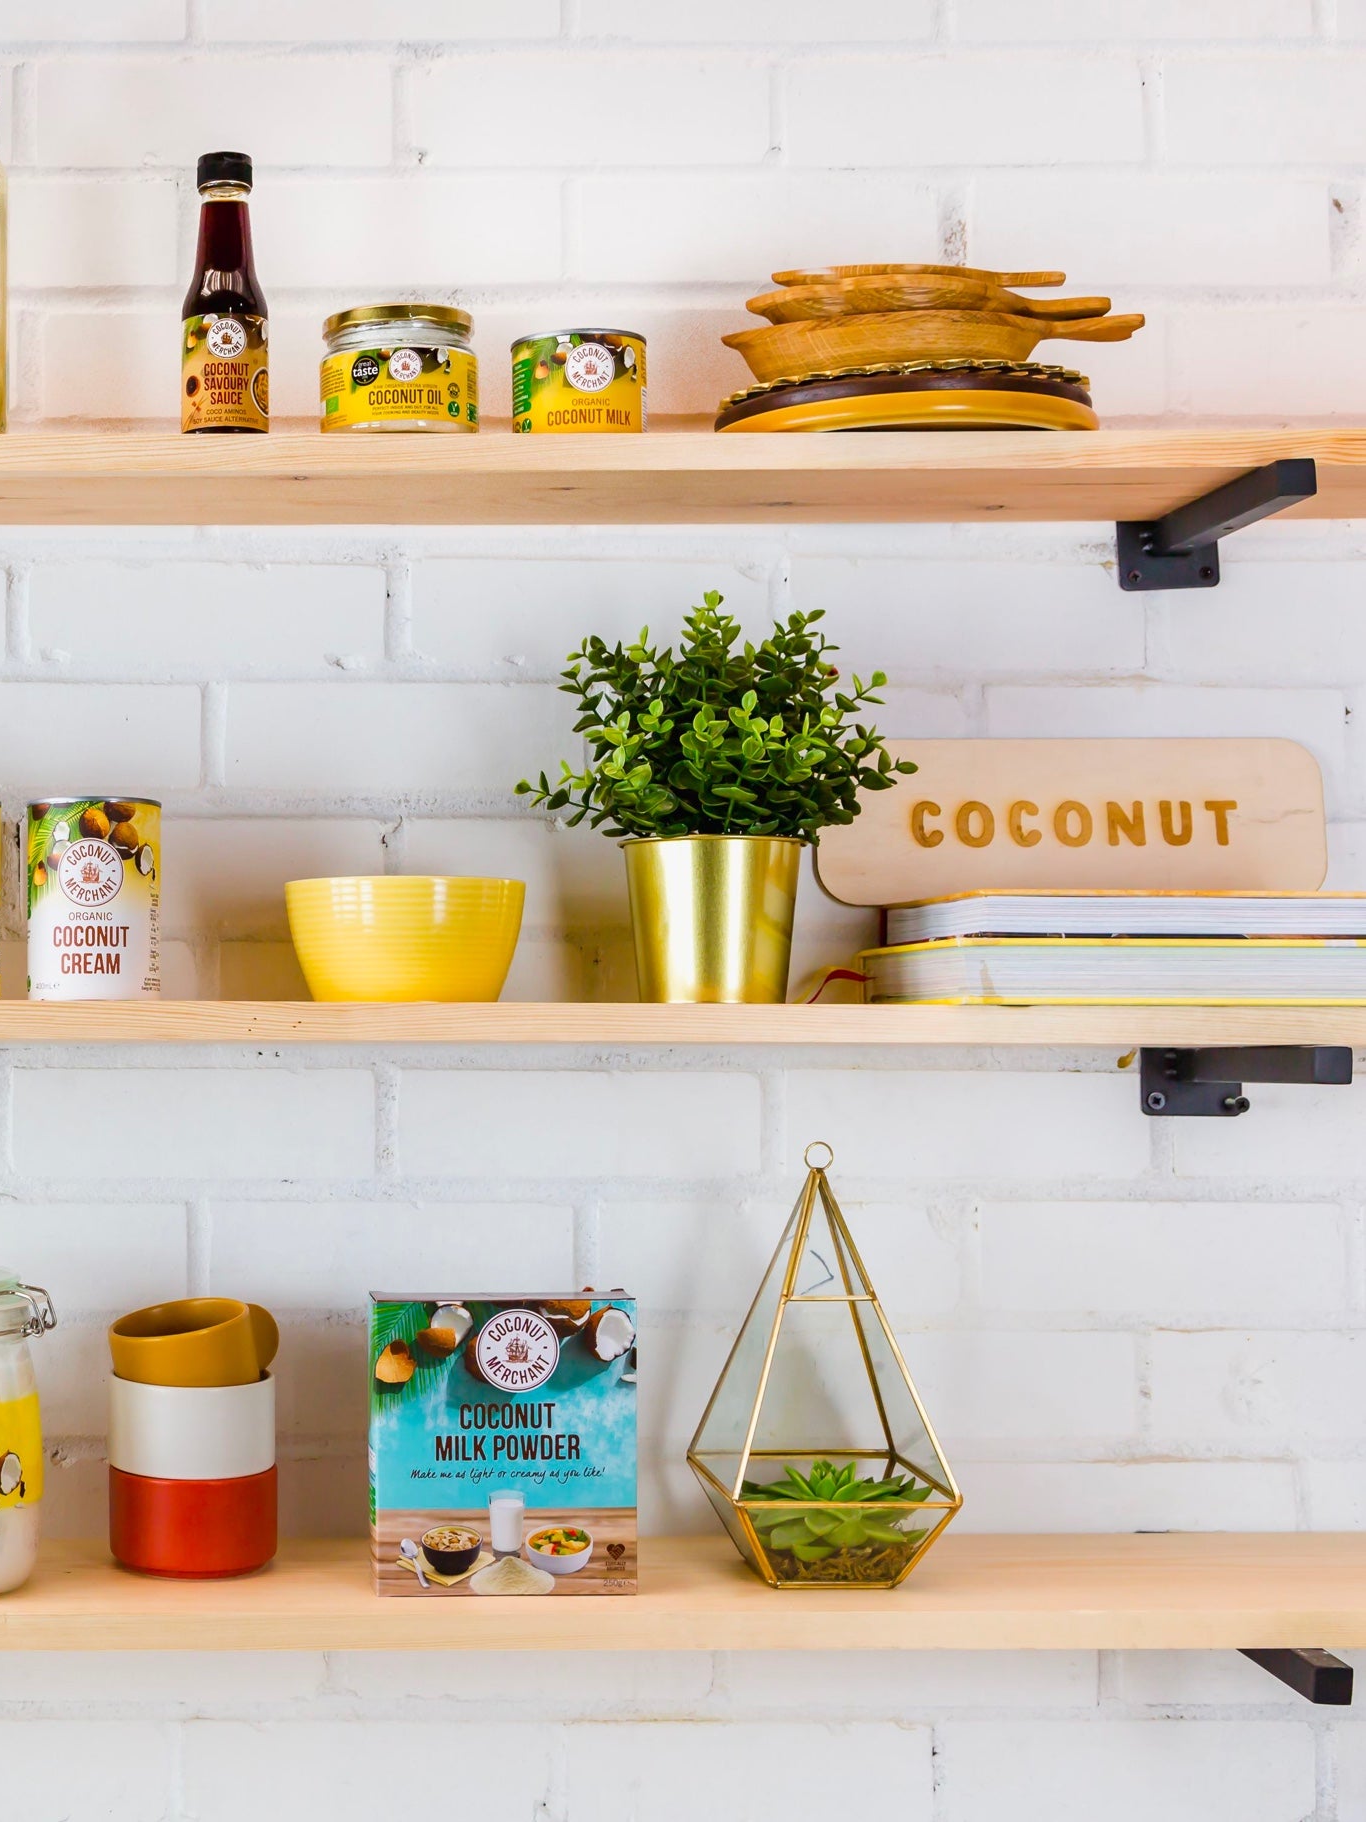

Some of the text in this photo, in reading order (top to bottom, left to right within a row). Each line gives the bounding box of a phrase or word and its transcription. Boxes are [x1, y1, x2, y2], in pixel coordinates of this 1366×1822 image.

[212, 321, 242, 335] COCONUT
[211, 341, 242, 356] MERCHANT
[572, 347, 609, 363] COCONUT
[357, 361, 372, 369] great
[394, 352, 418, 363] COCONUT
[203, 362, 250, 377] COCONUT
[352, 366, 379, 377] taste
[393, 367, 419, 380] MERCHANT
[203, 377, 250, 391] SAVOURY
[572, 370, 610, 389] MERCHANT
[210, 391, 243, 405] SAUCE
[368, 388, 424, 406] COCONUT
[427, 389, 444, 405] OIL
[572, 398, 610, 406] ORGANIC
[224, 416, 259, 424] ALTERNATIVE
[547, 408, 631, 426] COCONUT MILK
[910, 799, 1238, 849] COCONUT
[66, 844, 116, 866] COCONUT
[65, 876, 118, 902] MERCHANT
[68, 911, 113, 921] ORGANIC
[53, 925, 130, 948] COCONUT
[61, 952, 121, 975] CREAM
[487, 1316, 548, 1343] COCONUT
[486, 1355, 551, 1385] MERCHANT
[459, 1402, 556, 1430] COCONUT
[435, 1434, 581, 1461] MILK POWDER
[410, 1469, 437, 1479] Make
[455, 1470, 466, 1479] as
[470, 1469, 495, 1484] light
[497, 1470, 507, 1478] or
[510, 1470, 547, 1484] creamy
[549, 1469, 560, 1478] as
[558, 1469, 581, 1484] you
[583, 1467, 606, 1477] like!
